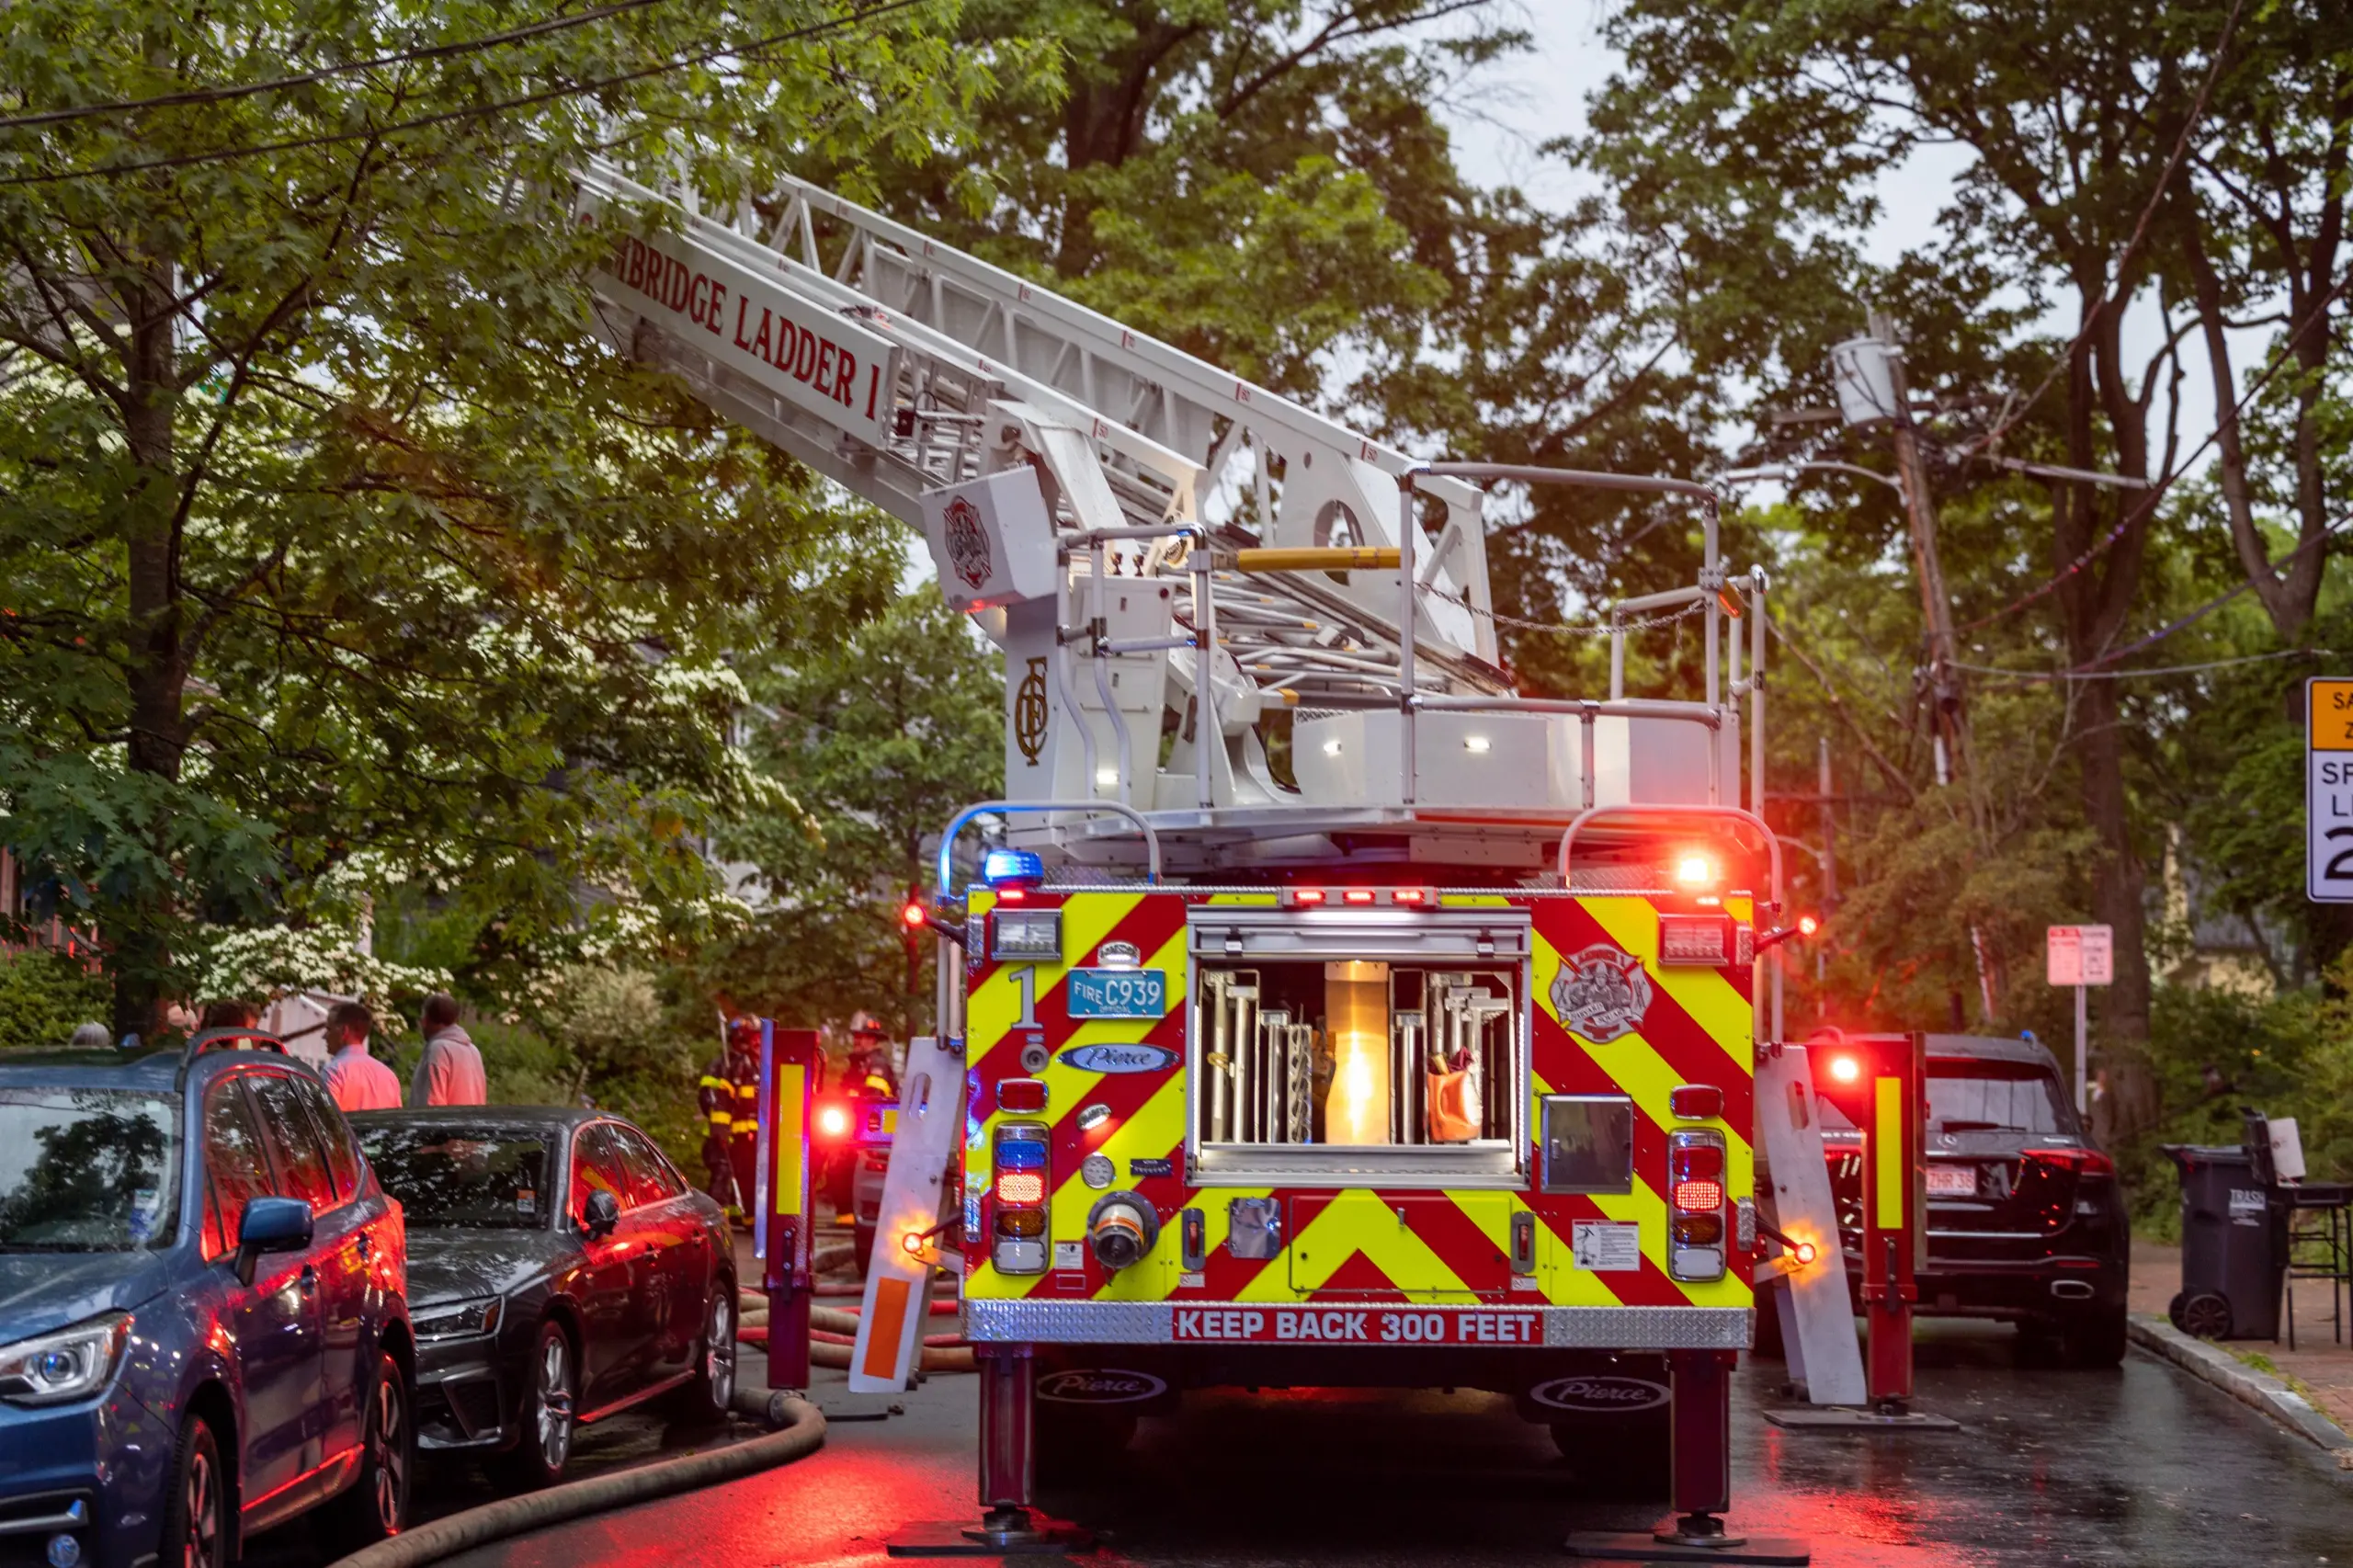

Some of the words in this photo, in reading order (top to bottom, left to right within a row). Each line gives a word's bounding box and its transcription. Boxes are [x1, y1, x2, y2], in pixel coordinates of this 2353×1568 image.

[733, 295, 858, 409] LADDER
[1008, 965, 1043, 1029] 1
[1074, 980, 1104, 1006] FIRE
[1106, 980, 1161, 1006] C939
[1085, 1047, 1151, 1068] Pierce
[1177, 1310, 1264, 1338] KEEP
[1276, 1312, 1368, 1340] BACK
[1381, 1313, 1445, 1341] 300
[1458, 1313, 1536, 1342] FEET
[1052, 1375, 1140, 1394] Pierce
[1557, 1381, 1645, 1401] Pierce
